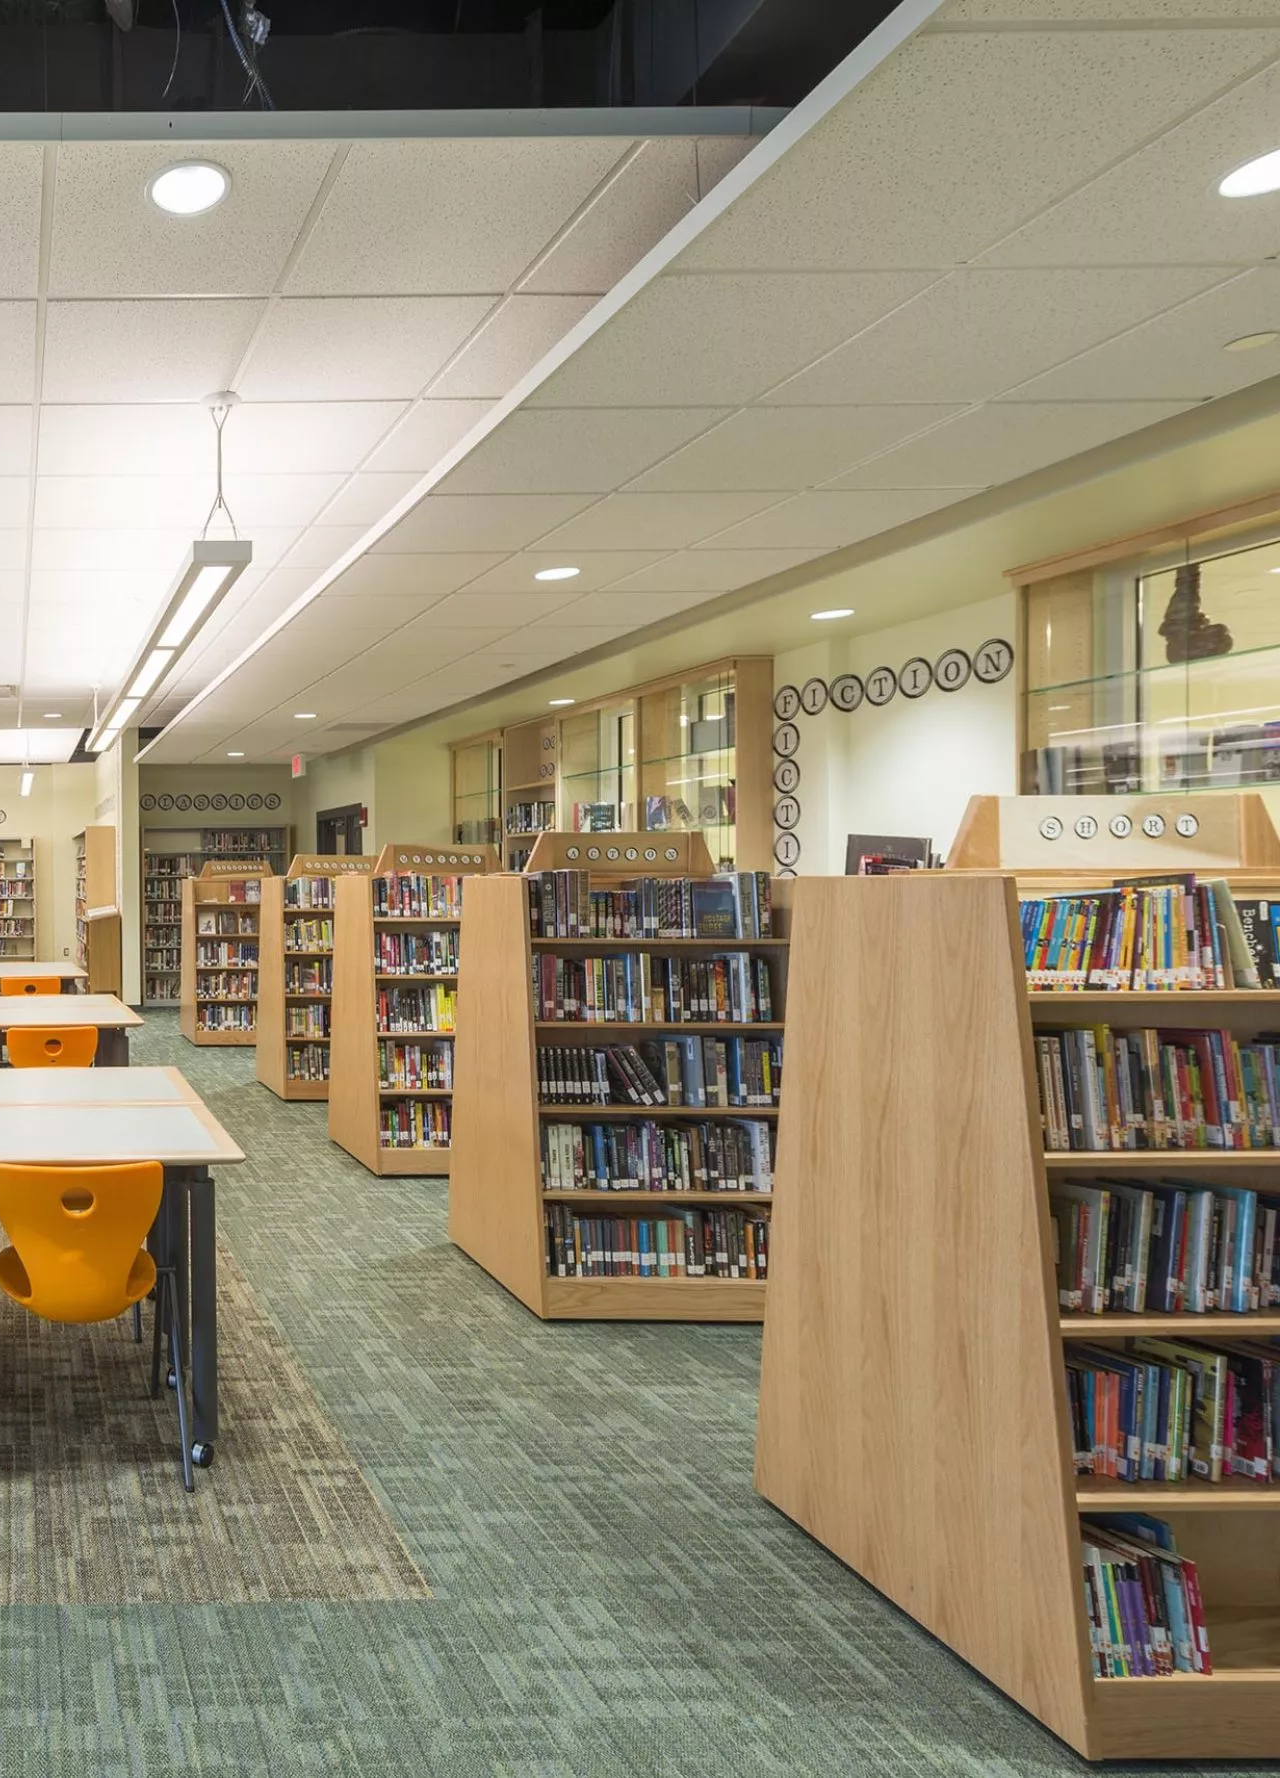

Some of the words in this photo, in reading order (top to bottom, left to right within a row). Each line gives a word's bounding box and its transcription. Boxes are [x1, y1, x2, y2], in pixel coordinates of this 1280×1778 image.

[778, 644, 1008, 718] FICTION
[777, 690, 797, 870] FICTI
[142, 795, 279, 809] CLASSICS
[1043, 817, 1196, 837] SHORT
[568, 848, 676, 860] ACTION
